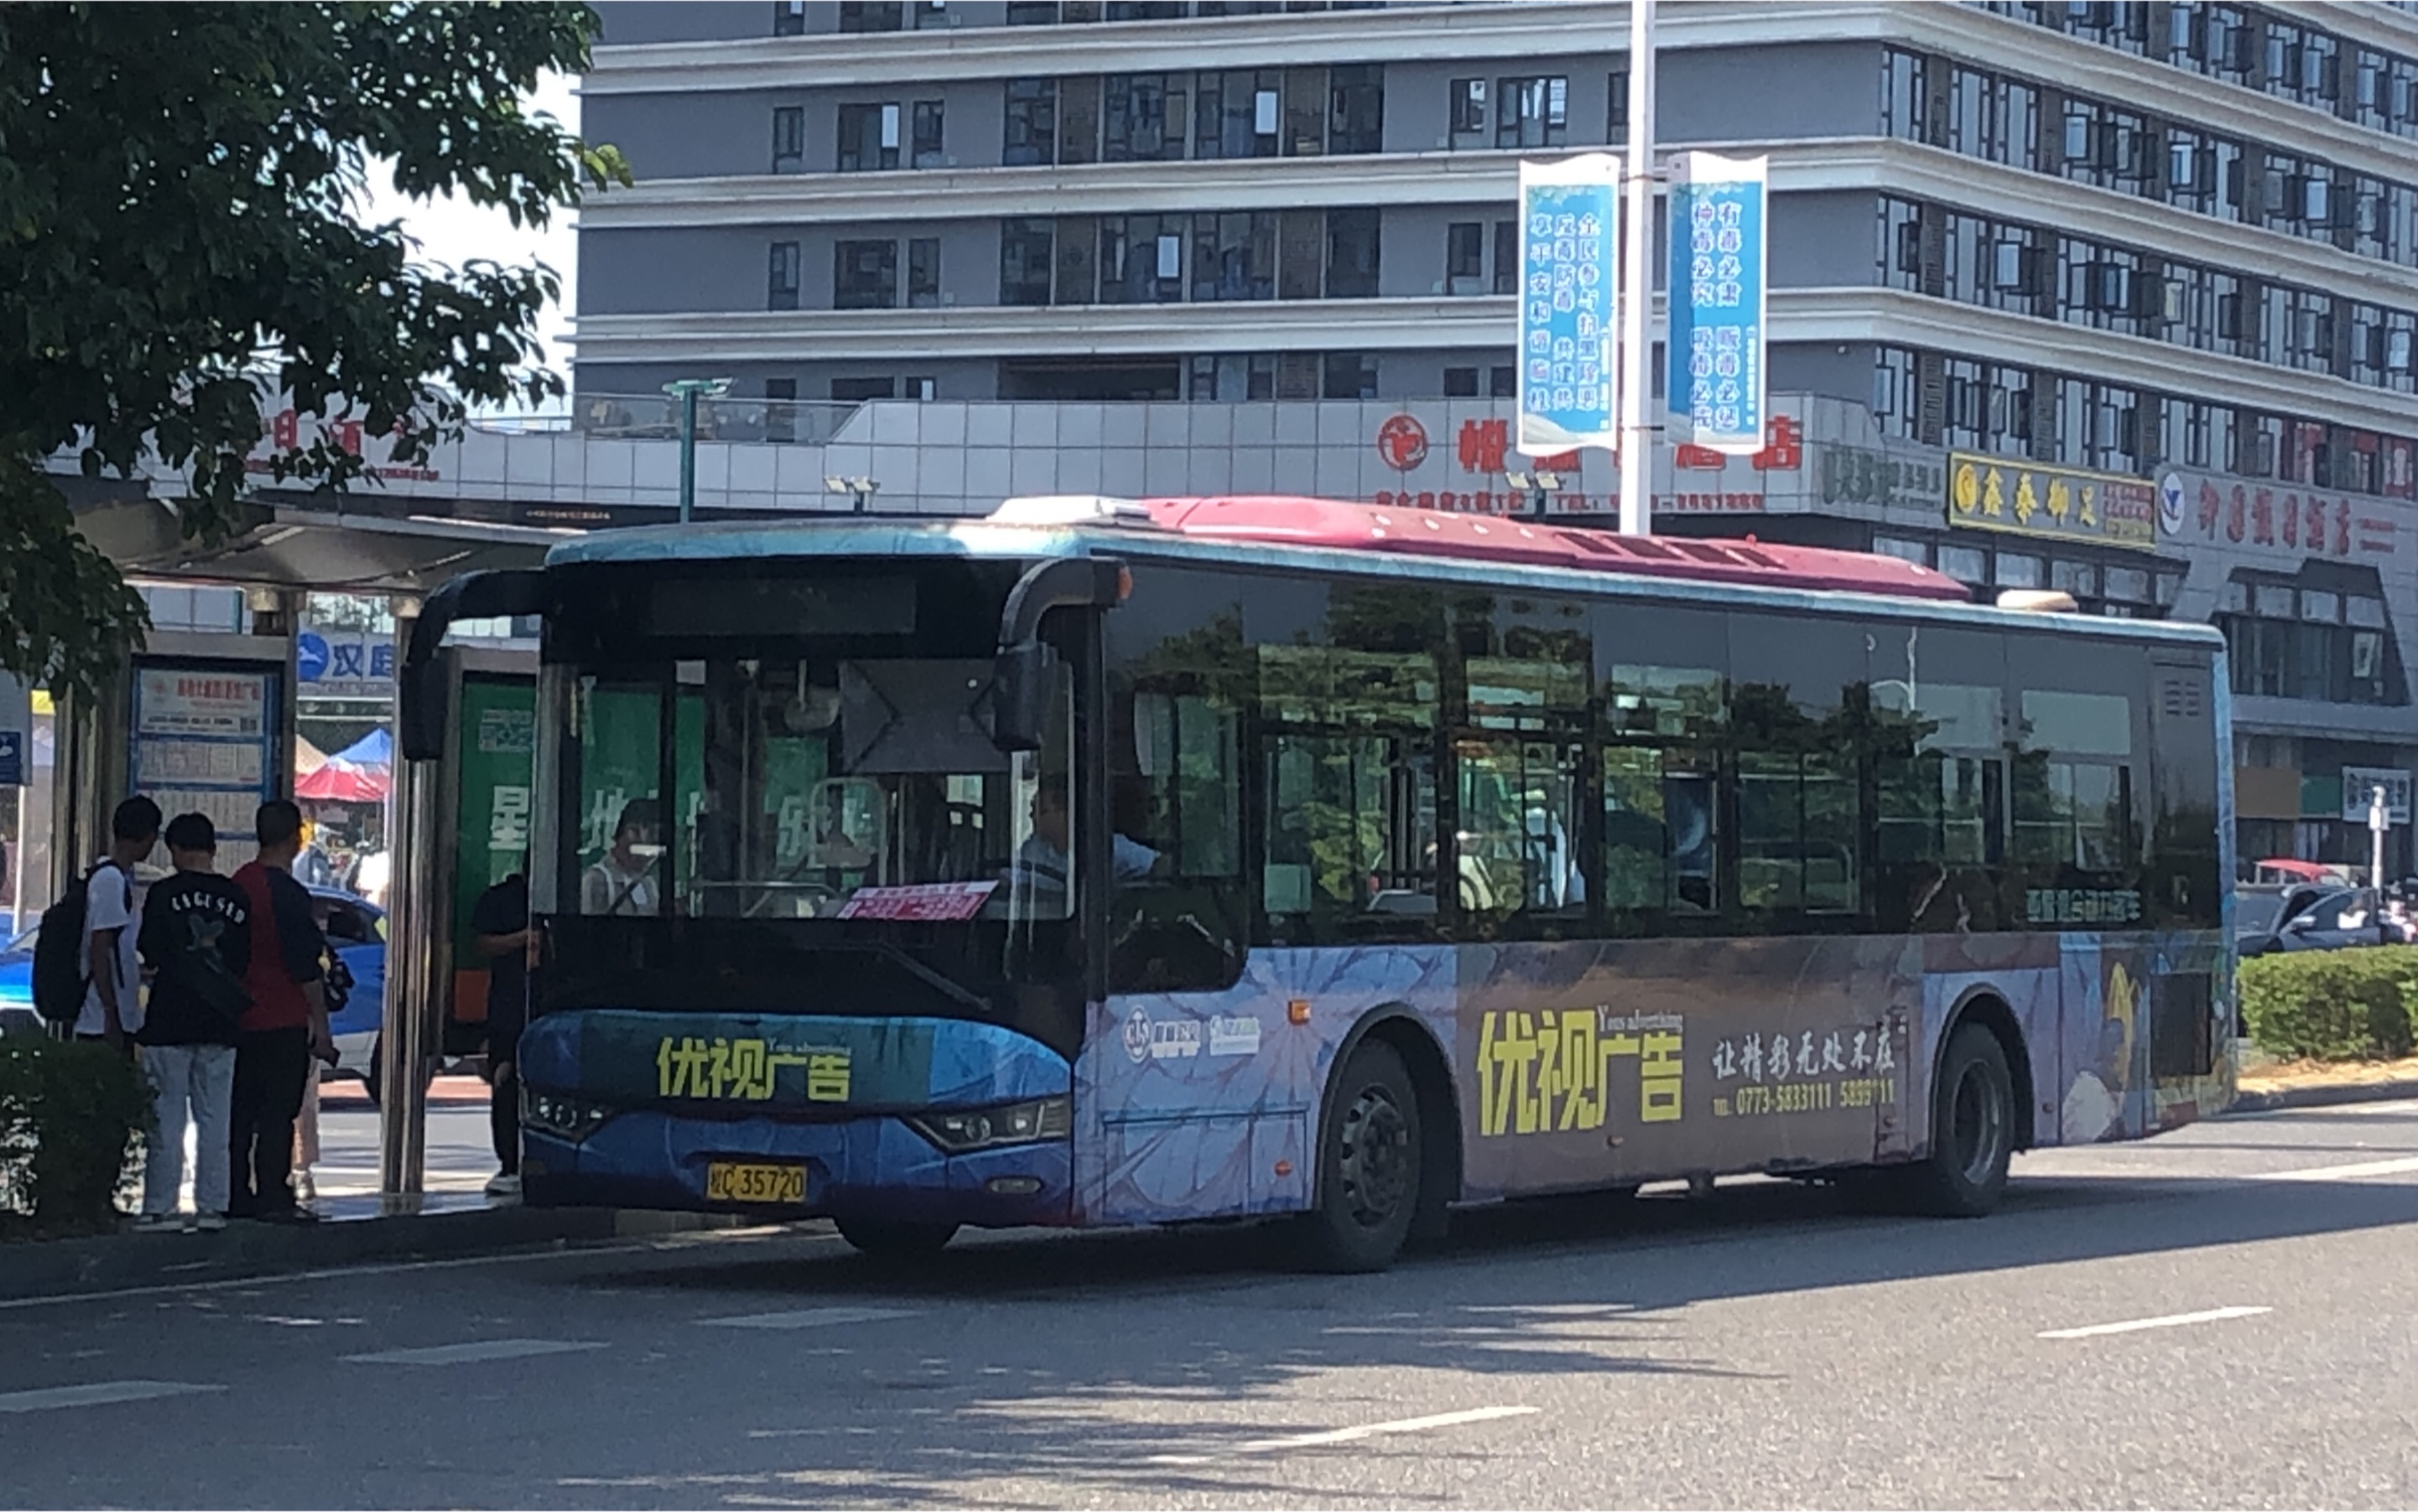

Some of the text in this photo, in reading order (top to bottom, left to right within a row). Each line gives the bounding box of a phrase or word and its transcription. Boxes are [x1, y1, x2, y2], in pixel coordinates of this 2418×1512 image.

[657, 1037, 850, 1102] 优视广告
[1477, 1010, 1683, 1136] 优视广告
[1712, 1028, 1895, 1083] 让精彩无处不在
[1736, 1083, 1832, 1115] 0773-5833111
